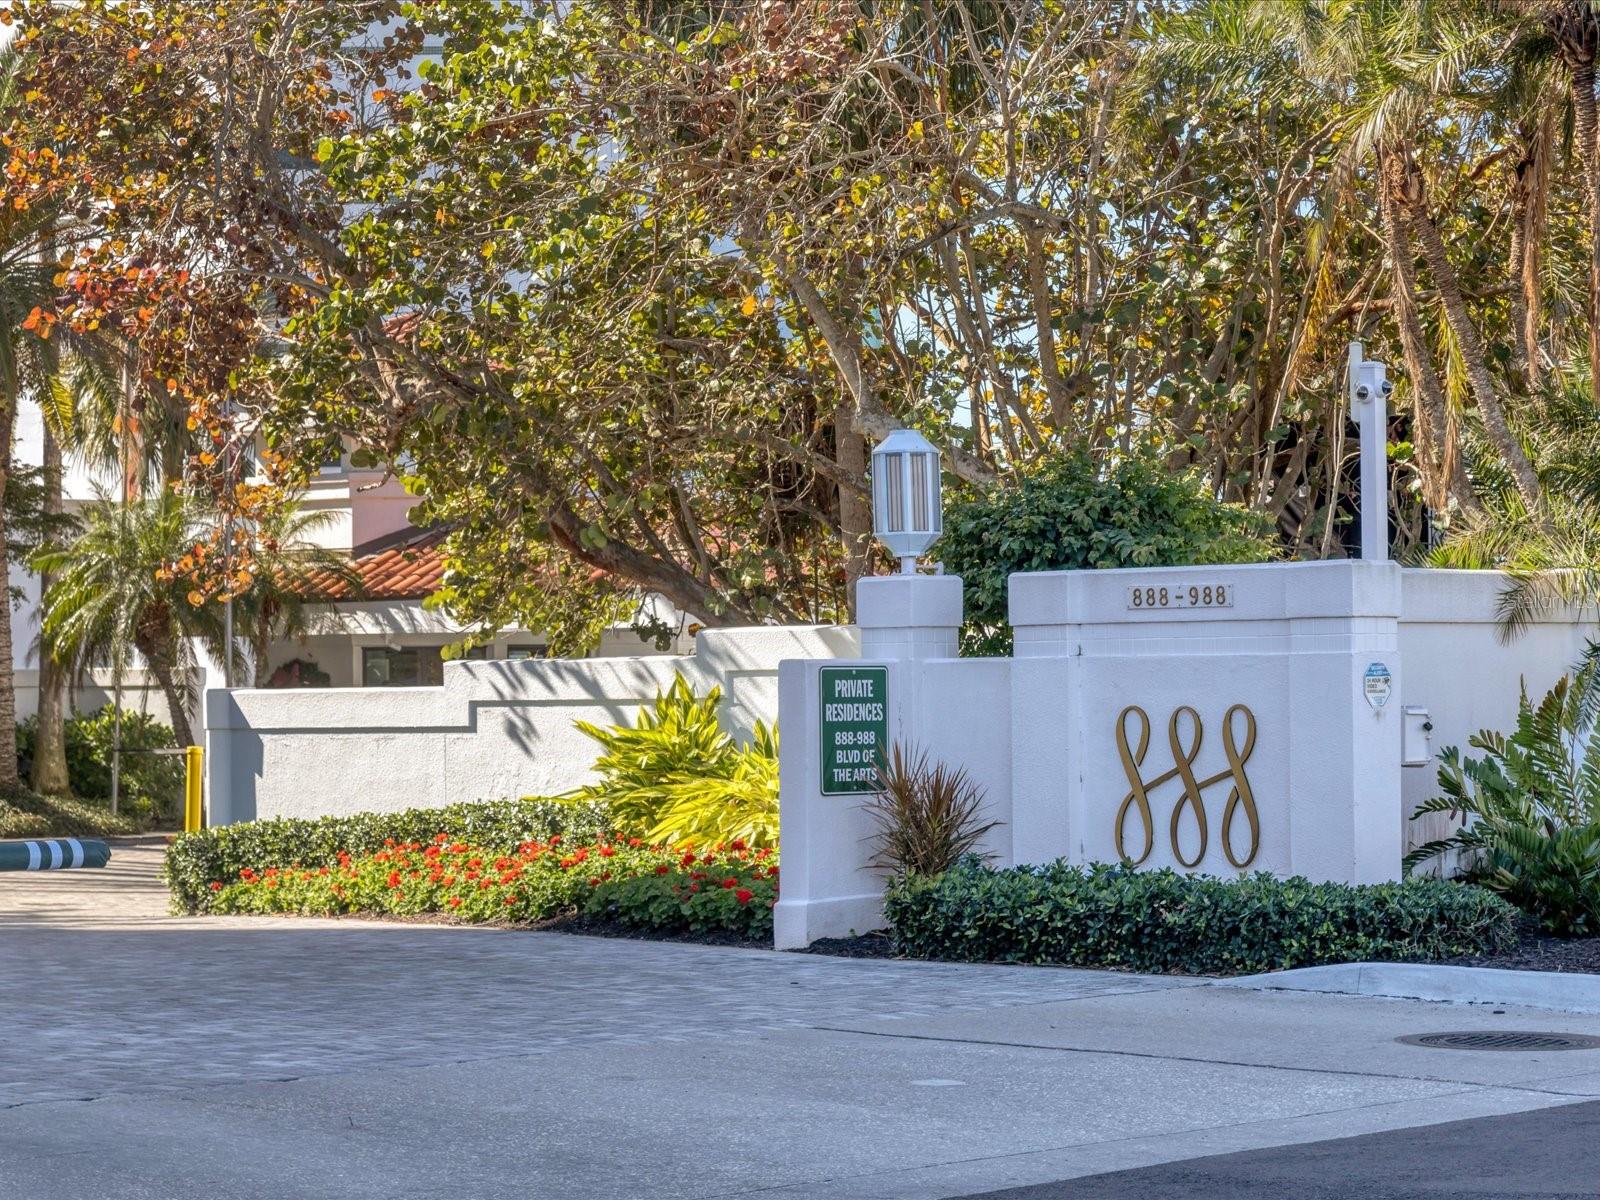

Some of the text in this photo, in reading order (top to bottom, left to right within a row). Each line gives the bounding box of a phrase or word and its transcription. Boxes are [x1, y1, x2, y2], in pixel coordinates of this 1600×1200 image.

[835, 680, 873, 698] PRIVATE
[825, 703, 883, 722] RESIDENCES
[835, 731, 876, 745] 888-988
[836, 750, 875, 763] BLVD OF
[833, 767, 877, 782] THE ARTS
